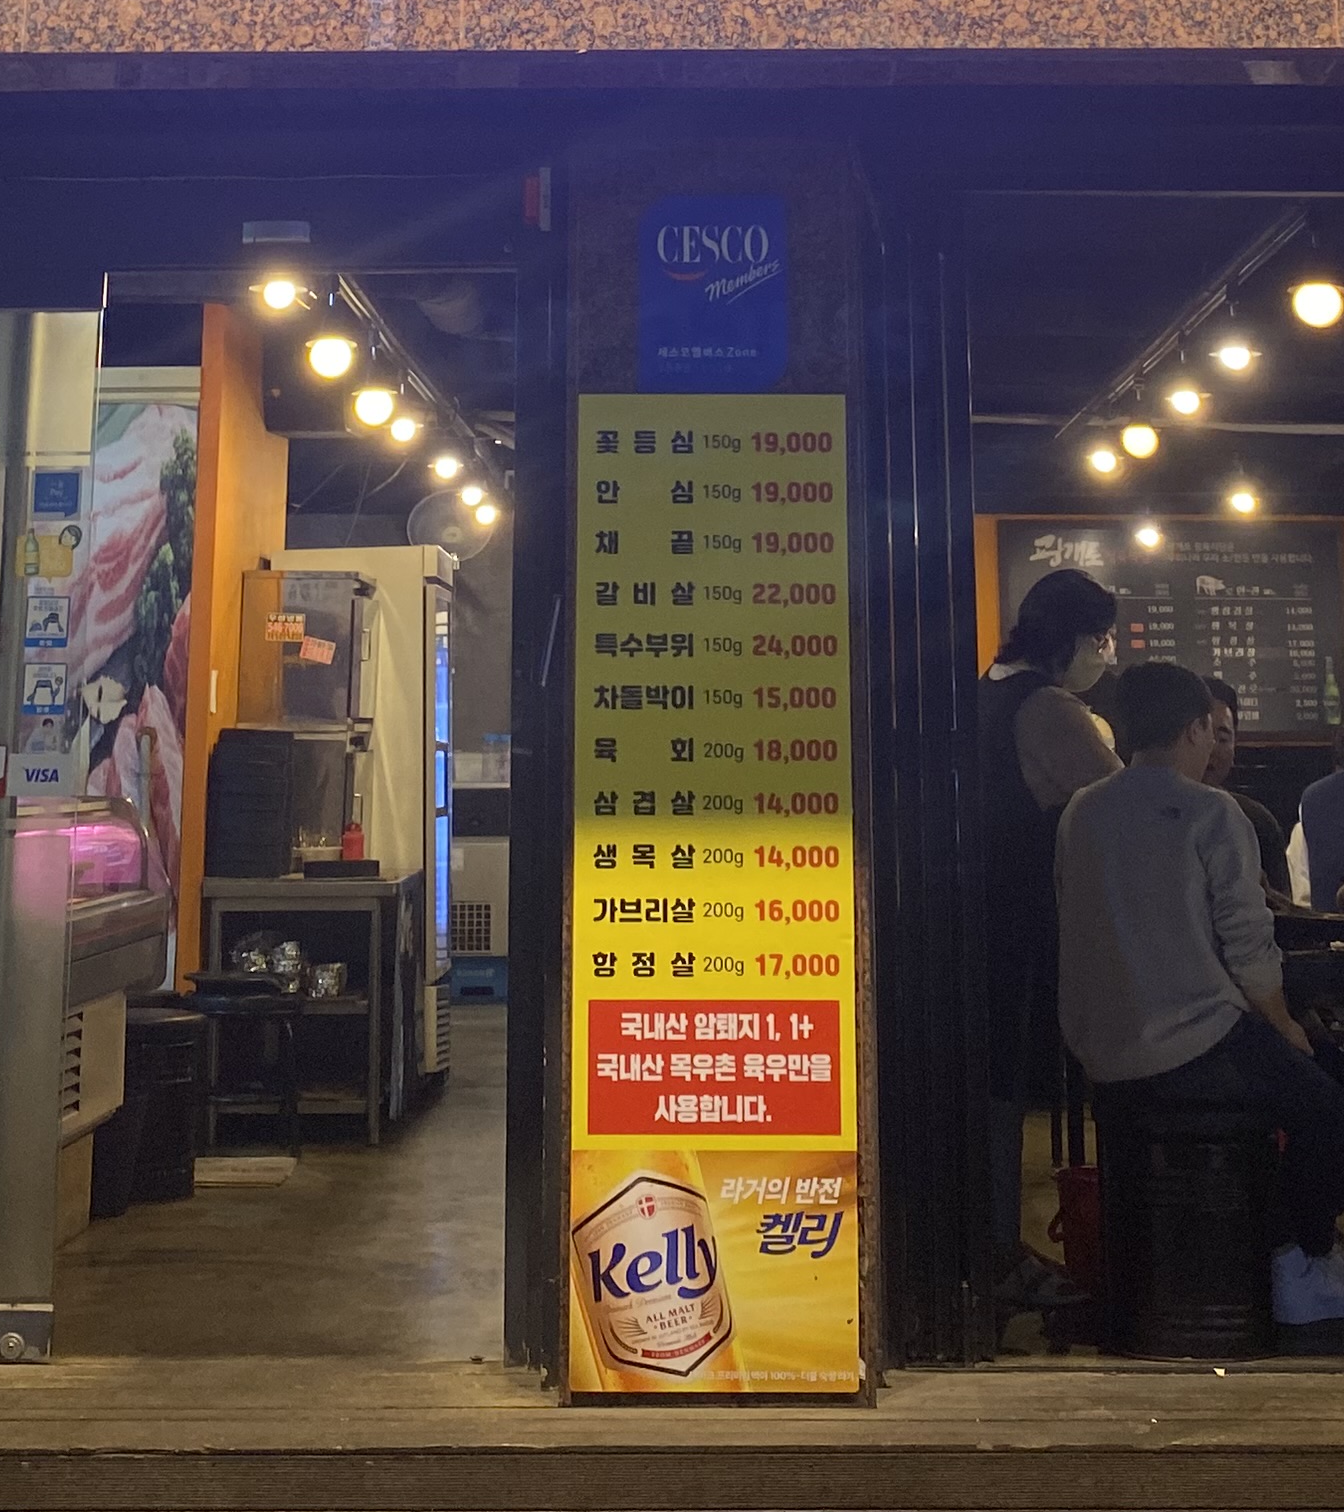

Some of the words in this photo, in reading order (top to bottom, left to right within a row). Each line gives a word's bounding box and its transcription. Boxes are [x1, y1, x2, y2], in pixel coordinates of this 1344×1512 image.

[656, 224, 769, 264] CESCO
[704, 258, 782, 303] Members
[594, 430, 695, 455] 꽃등심
[702, 432, 744, 455] 150g
[751, 431, 833, 456] 19,000
[702, 482, 744, 505] 150g
[751, 481, 834, 506] 19,000
[702, 532, 744, 555] 150g
[751, 531, 835, 556] 19,000
[1029, 534, 1104, 567] 광개토
[594, 582, 695, 607] 갈비살
[702, 583, 744, 607] 150g
[751, 583, 836, 608] 22,000
[594, 633, 695, 658] 특수부위
[702, 635, 744, 658] 150g
[751, 634, 837, 659] 24,000
[594, 686, 695, 711] 차돌박이
[702, 688, 744, 711] 150g
[751, 687, 838, 712] 15,000
[702, 740, 744, 763] 200g
[751, 739, 839, 764] 18,000
[25, 768, 59, 783] VISA
[591, 790, 697, 816] 삼겹살
[701, 792, 745, 816] 200g
[753, 791, 841, 819] 14,000
[591, 843, 697, 870] 생목살
[701, 845, 745, 869] 200g
[753, 844, 841, 872] 14,000
[591, 897, 697, 924] 가브리살
[701, 900, 745, 923] 200g
[753, 898, 841, 926] 16,000
[591, 952, 697, 978] 항정살
[701, 954, 745, 978] 200g
[753, 953, 841, 980] 17,000
[619, 1012, 688, 1042] 국내산
[764, 1013, 780, 1044] 1,
[787, 1013, 814, 1042] 1+
[595, 1053, 664, 1083] 국내산
[669, 1053, 736, 1083] 목우촌
[742, 1053, 833, 1083] 육우만을
[654, 1094, 773, 1125] 사용합니다.
[719, 1177, 789, 1205] 라거의
[794, 1177, 842, 1205] 반전
[755, 1210, 845, 1259] 켈리
[588, 1223, 717, 1303] Kelly
[646, 1310, 666, 1324] ALL
[669, 1304, 696, 1318] MALT
[659, 1316, 687, 1331] BEER
